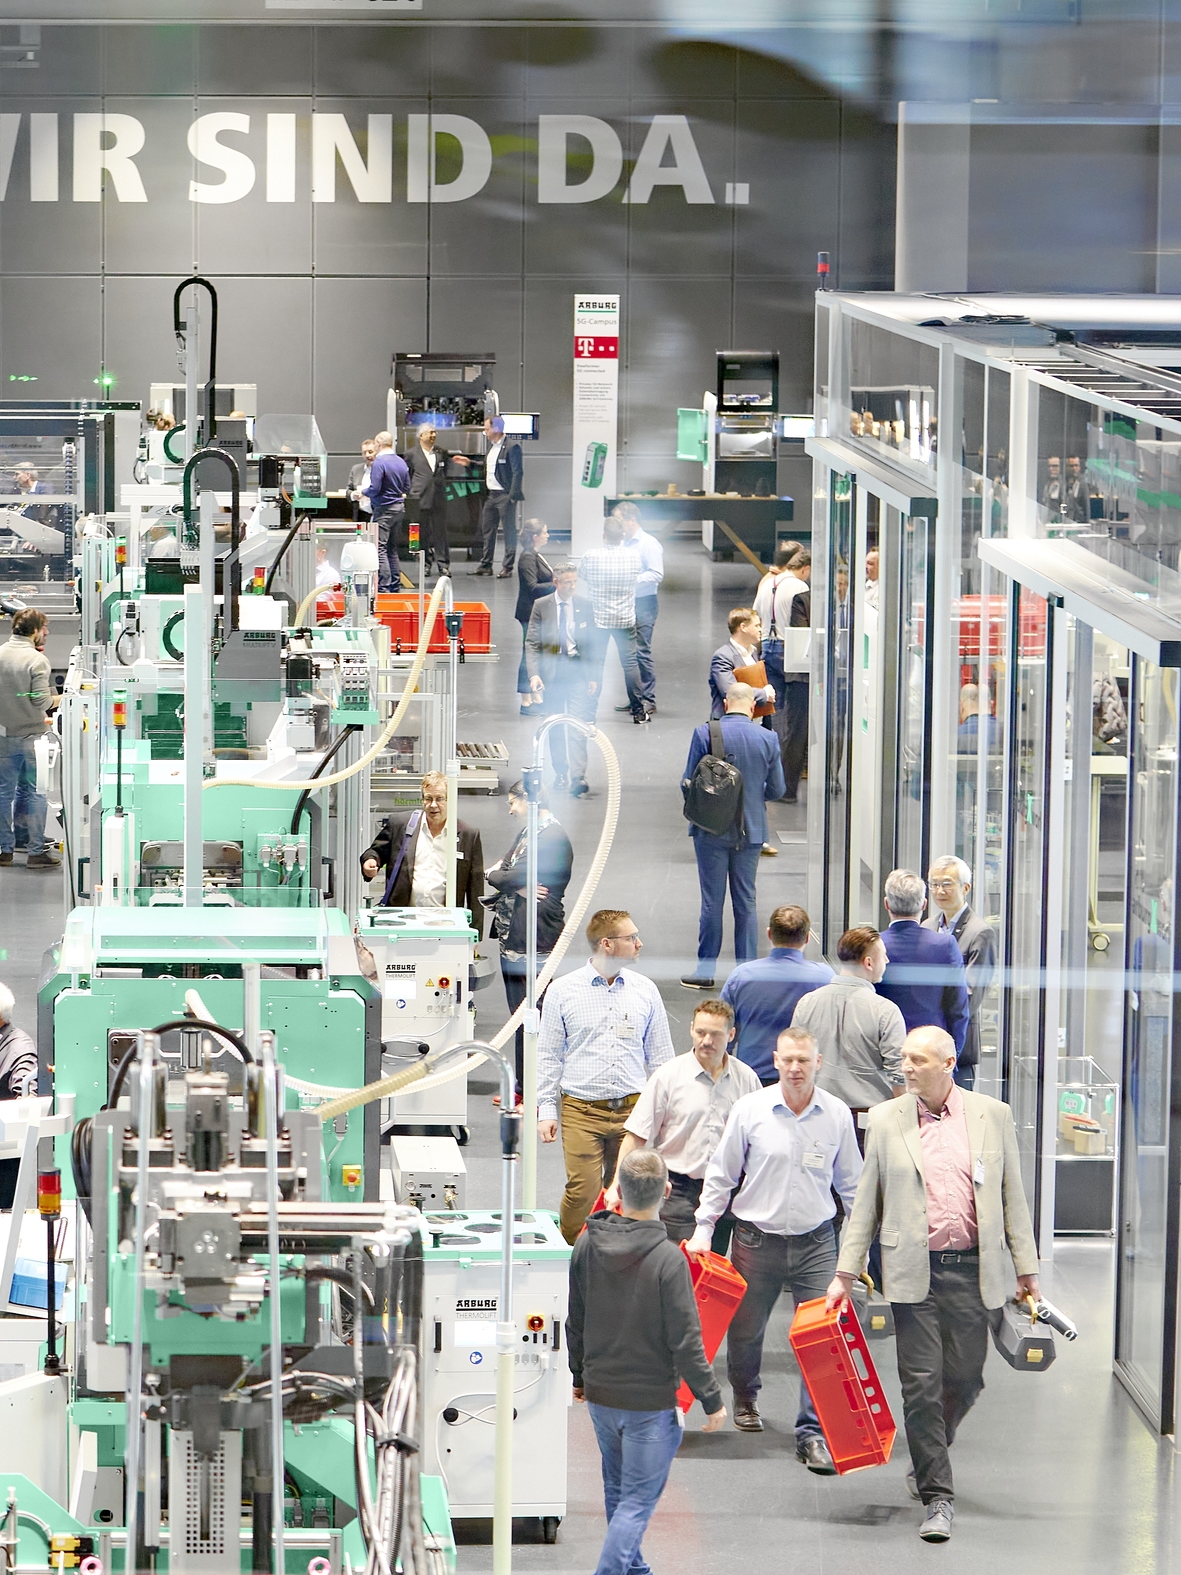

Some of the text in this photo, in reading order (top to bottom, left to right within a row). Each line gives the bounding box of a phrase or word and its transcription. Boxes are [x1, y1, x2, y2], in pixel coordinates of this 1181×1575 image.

[188, 112, 493, 204] SIND
[537, 114, 750, 204] DA.
[577, 318, 617, 326] 5G-Campus
[456, 1300, 496, 1308] ARBURG
